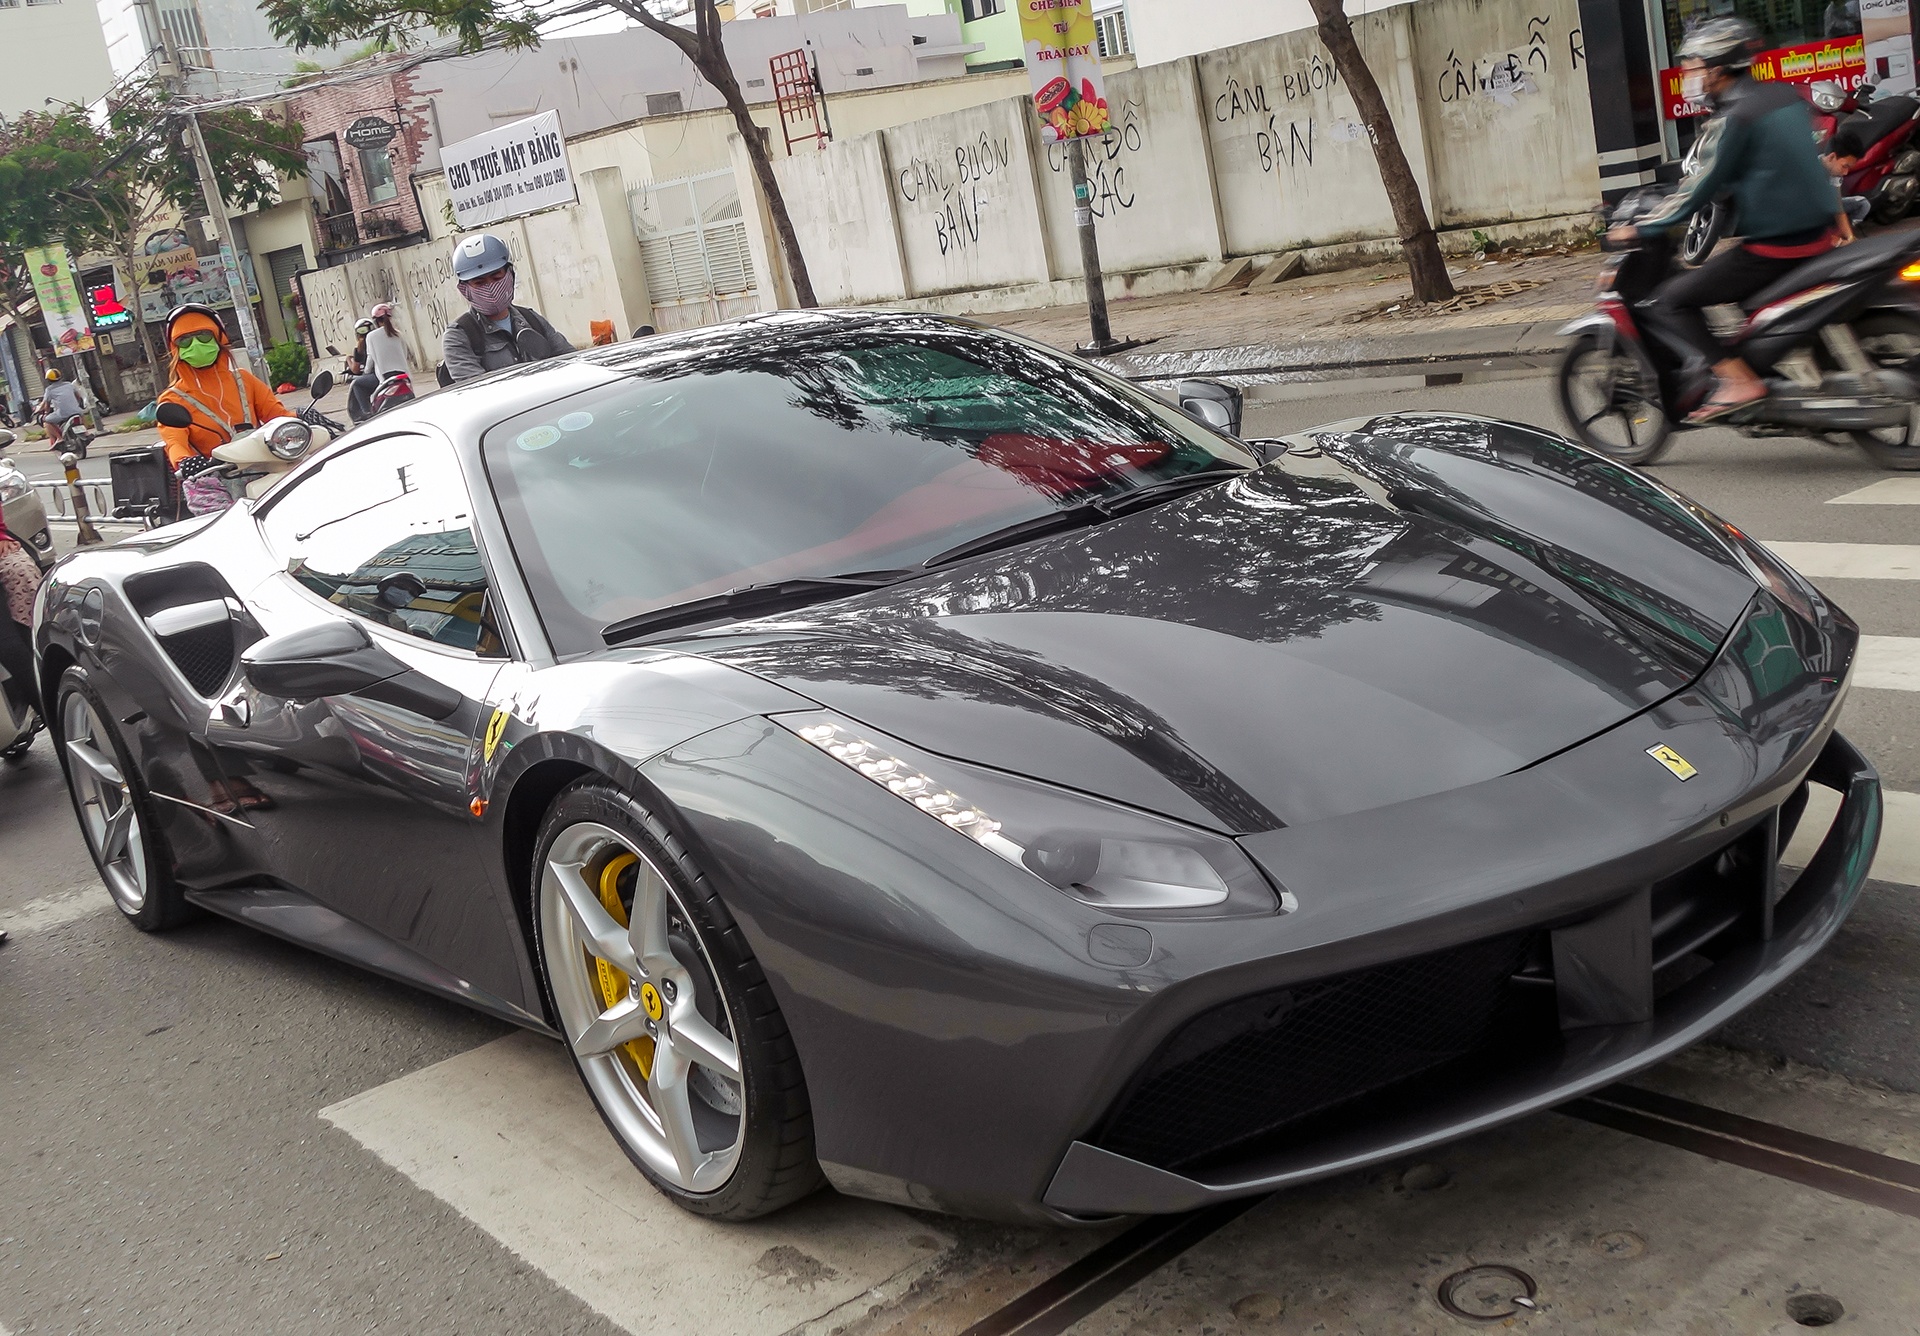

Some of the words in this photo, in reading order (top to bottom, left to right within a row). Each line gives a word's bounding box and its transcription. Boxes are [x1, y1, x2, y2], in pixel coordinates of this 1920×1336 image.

[1283, 55, 1338, 102] BUÔN
[350, 126, 391, 138] HOME
[448, 162, 471, 190] CHO
[470, 145, 502, 183] THUÊ
[500, 140, 527, 177] MẶT
[527, 126, 561, 166] BẰNG
[955, 130, 1008, 184] BUÔN
[1257, 114, 1312, 173] BÁN
[934, 183, 979, 256] BÁN
